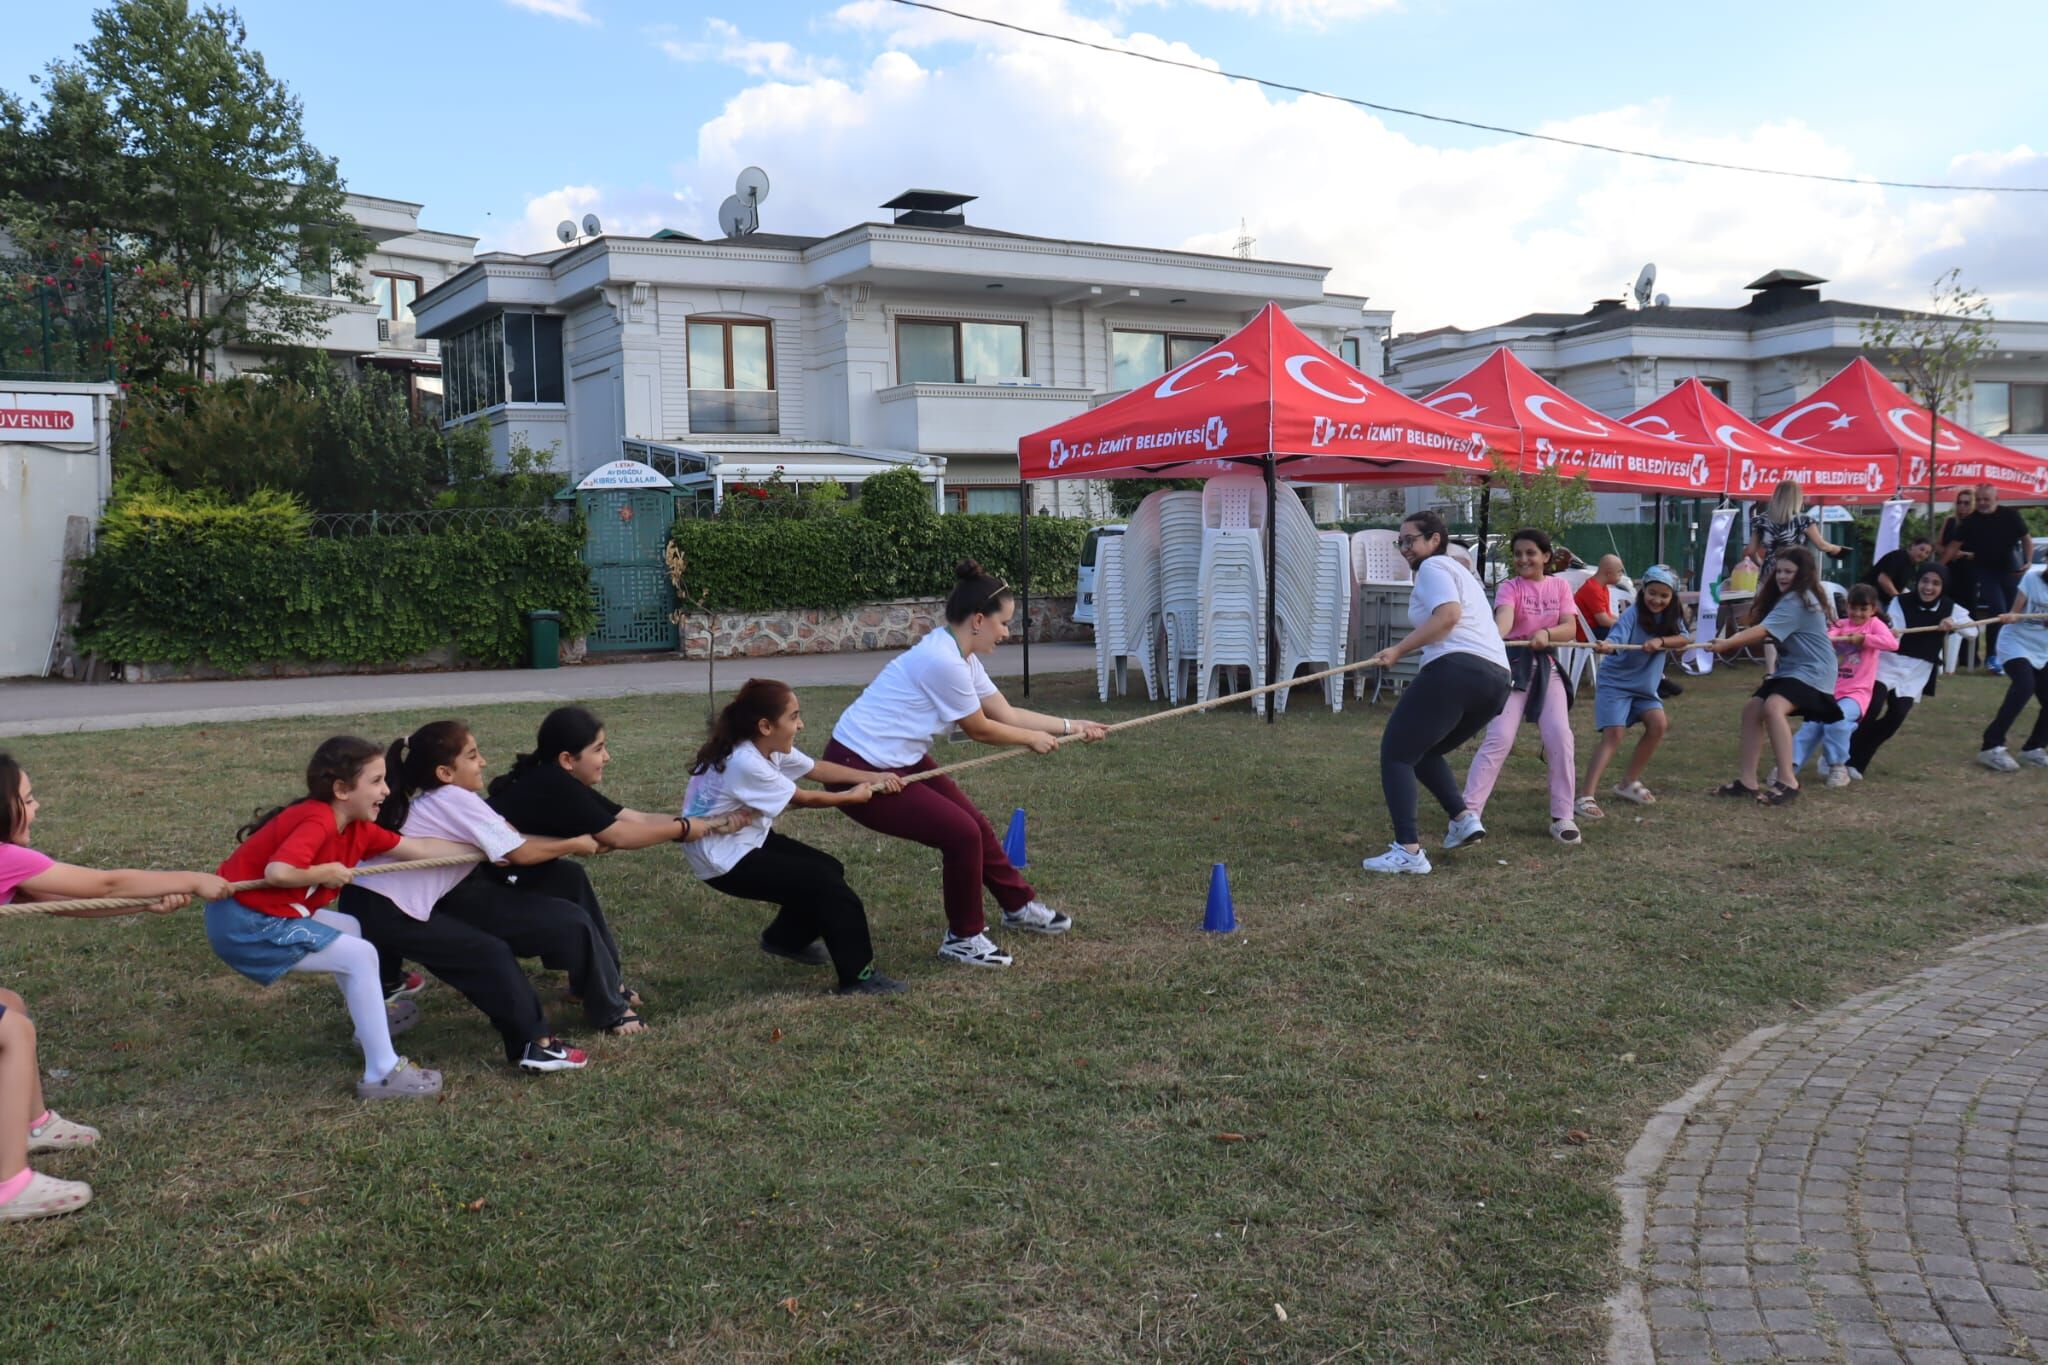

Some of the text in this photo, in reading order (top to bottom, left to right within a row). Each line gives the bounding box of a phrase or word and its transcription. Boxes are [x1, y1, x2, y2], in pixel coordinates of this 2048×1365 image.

[1097, 436, 1133, 455] İZMİT
[1136, 424, 1206, 450] BELEDİYESİ
[1366, 422, 1404, 442] İZMİT
[1407, 428, 1473, 453] BELEDİYESİ
[1588, 448, 1625, 470] İZMİT
[1628, 456, 1692, 477] BELEDİYESİ
[1782, 466, 1812, 484] İZMİT
[1815, 468, 1868, 485] BELEDİYESİ
[1951, 461, 1983, 477] İZMİT
